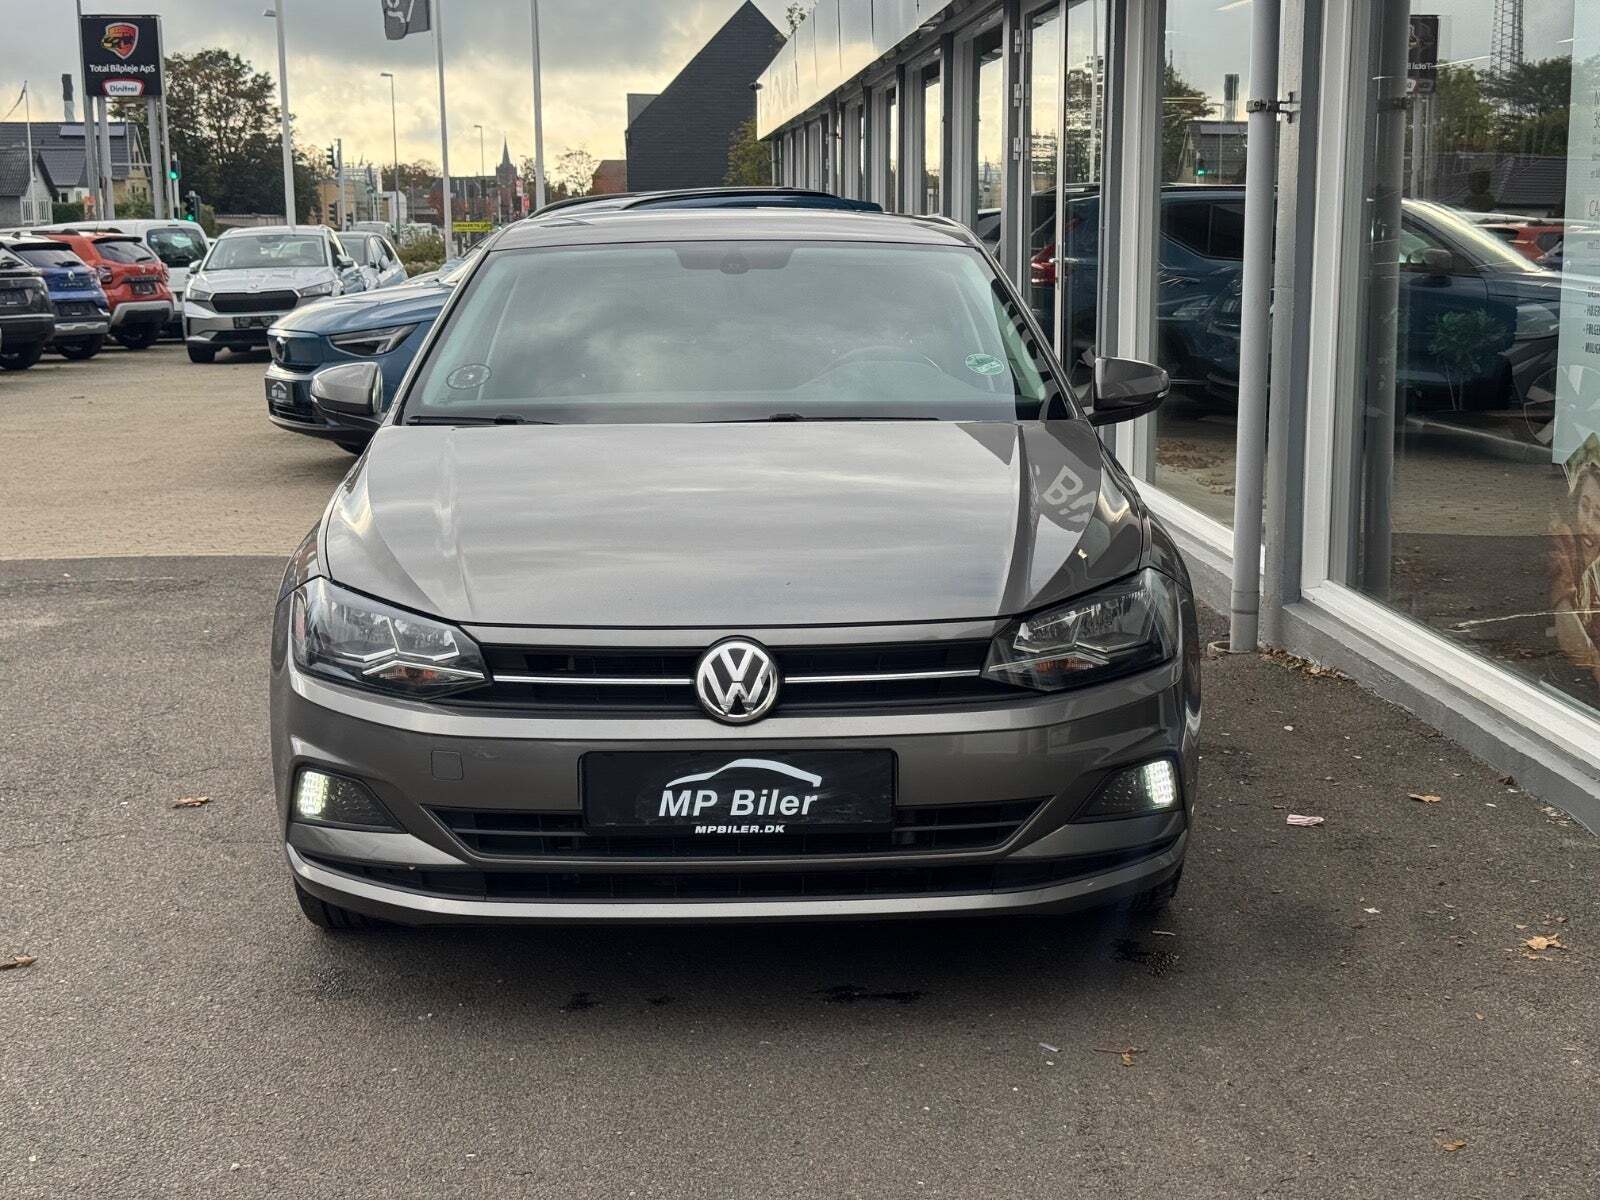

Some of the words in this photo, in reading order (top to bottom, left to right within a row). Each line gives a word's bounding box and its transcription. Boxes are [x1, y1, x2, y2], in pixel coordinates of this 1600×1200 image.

[89, 64, 109, 73] Total
[110, 64, 139, 75] Bilpleje
[140, 64, 156, 75] ApS
[658, 790, 718, 817] MP
[729, 788, 818, 816] Biler
[694, 824, 786, 834] MPBILER.DK
